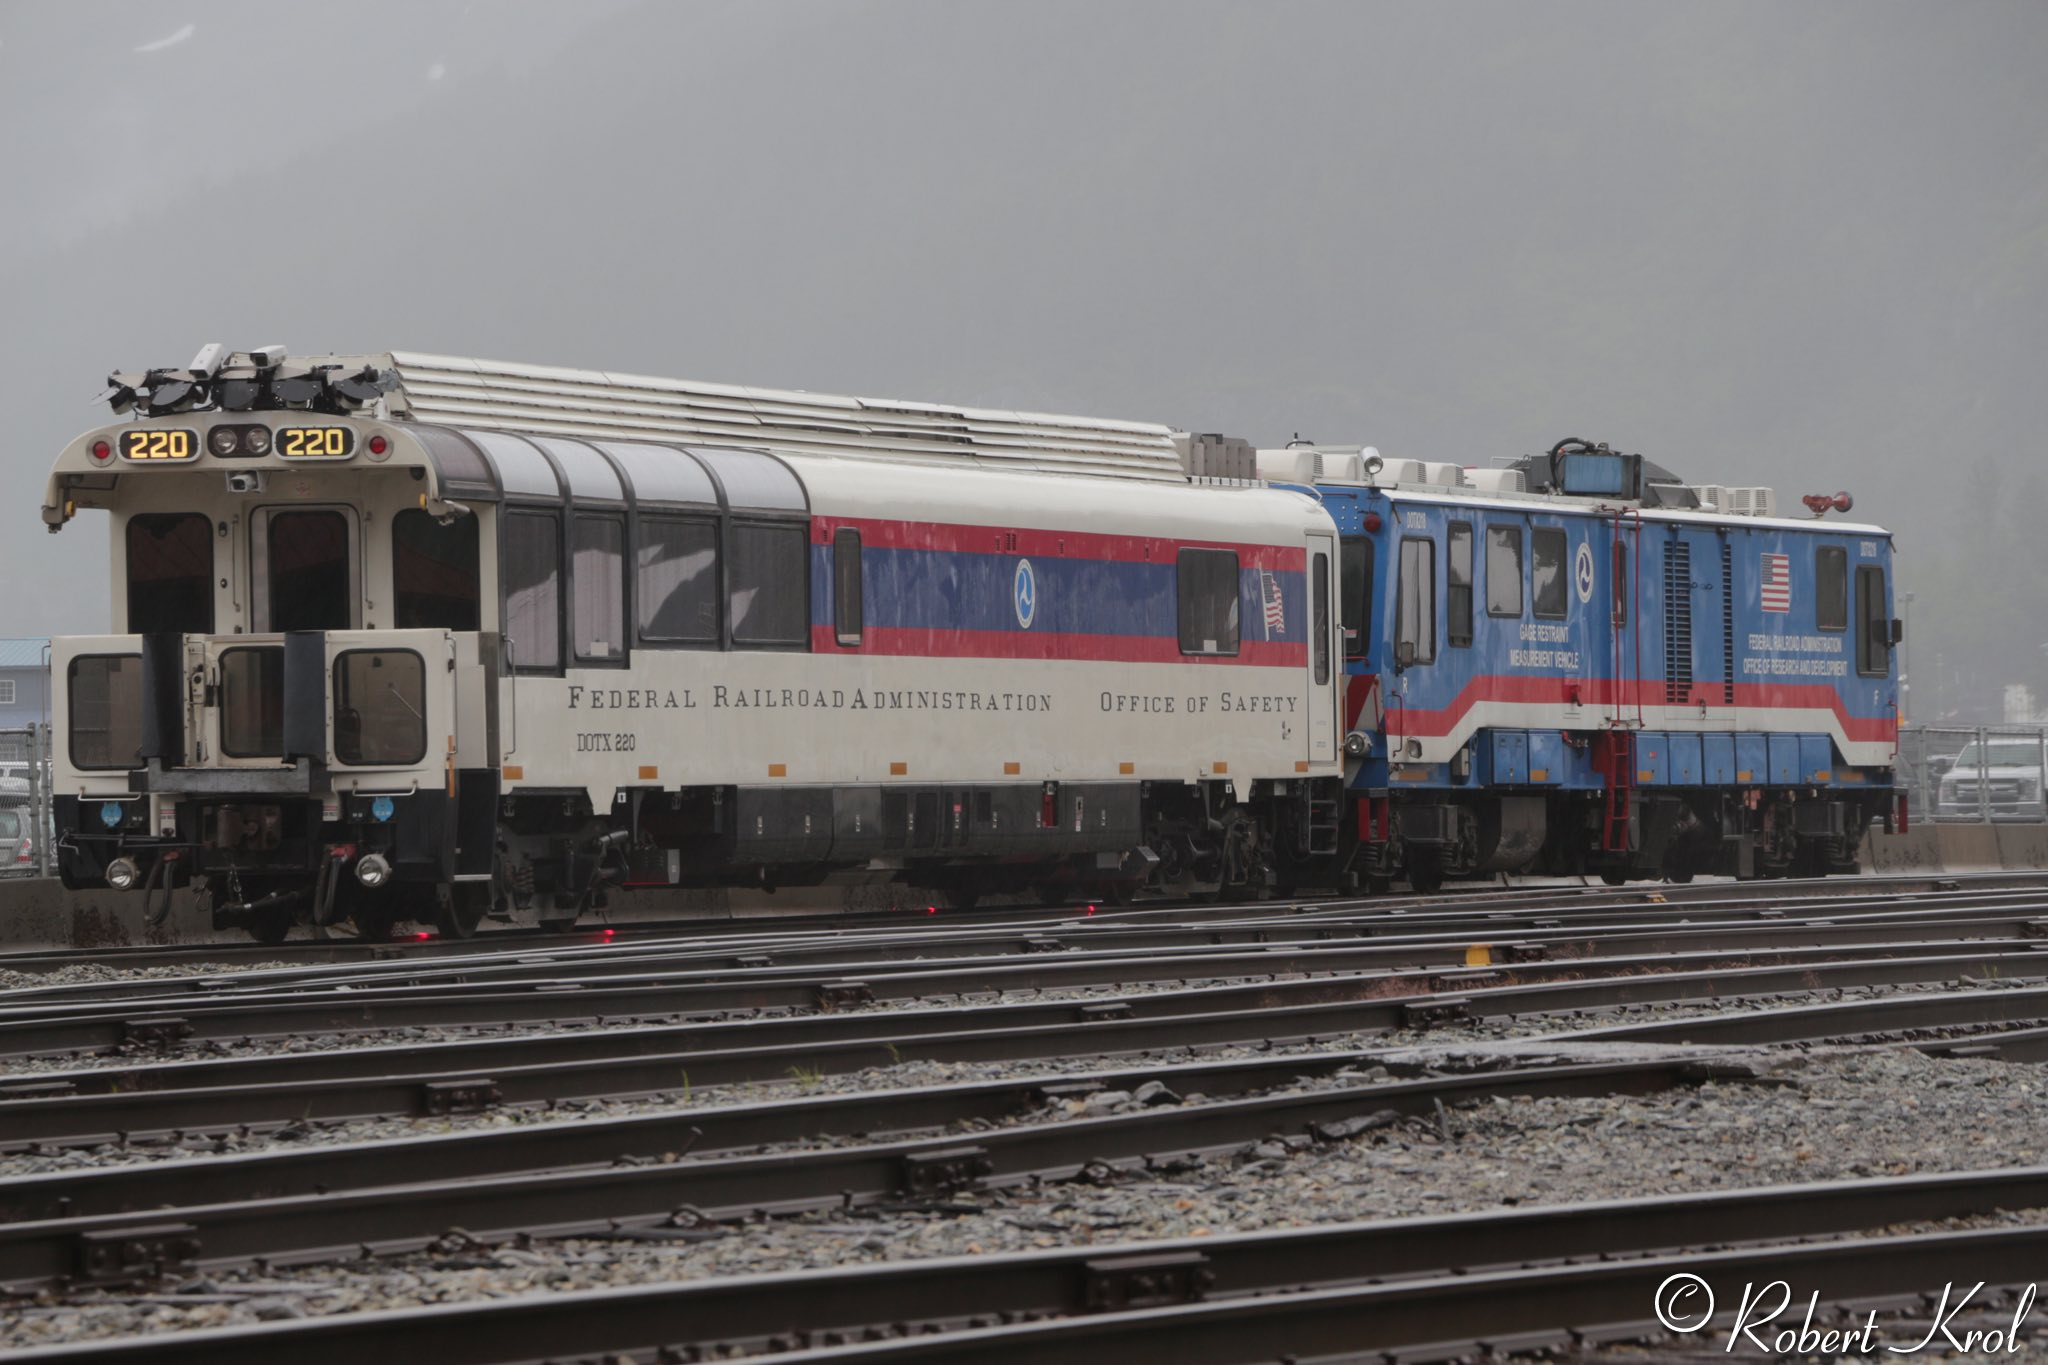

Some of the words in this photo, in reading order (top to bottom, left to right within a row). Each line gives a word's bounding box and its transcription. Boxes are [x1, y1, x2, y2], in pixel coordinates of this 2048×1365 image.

[129, 431, 188, 459] 220
[285, 428, 344, 456] 220
[1520, 623, 1537, 640] GAGE
[1537, 625, 1569, 643] RESTRAINT
[1748, 634, 1771, 651] FEDERAL
[1773, 635, 1800, 652] RAILROAD
[1801, 636, 1842, 653] ADMINISTRATION
[1510, 649, 1553, 667] MEASUREMENT
[1554, 651, 1579, 668] VEHICLE
[1743, 658, 1762, 674] OFFICE
[1763, 659, 1770, 674] OF
[1771, 659, 1799, 675] RESEARCH
[1800, 660, 1810, 675] AND
[1811, 660, 1848, 676] DEVELOPMENT
[1402, 677, 1408, 694] R
[568, 686, 696, 709] FEDERAL
[713, 685, 844, 708] RAILROAD
[850, 688, 1052, 711] ADMINISTRATION
[1100, 692, 1175, 713] OFFICE
[1187, 696, 1209, 713] OF
[1221, 692, 1298, 713] SAFETY
[577, 733, 612, 752] DOTX
[615, 733, 636, 751] 220
